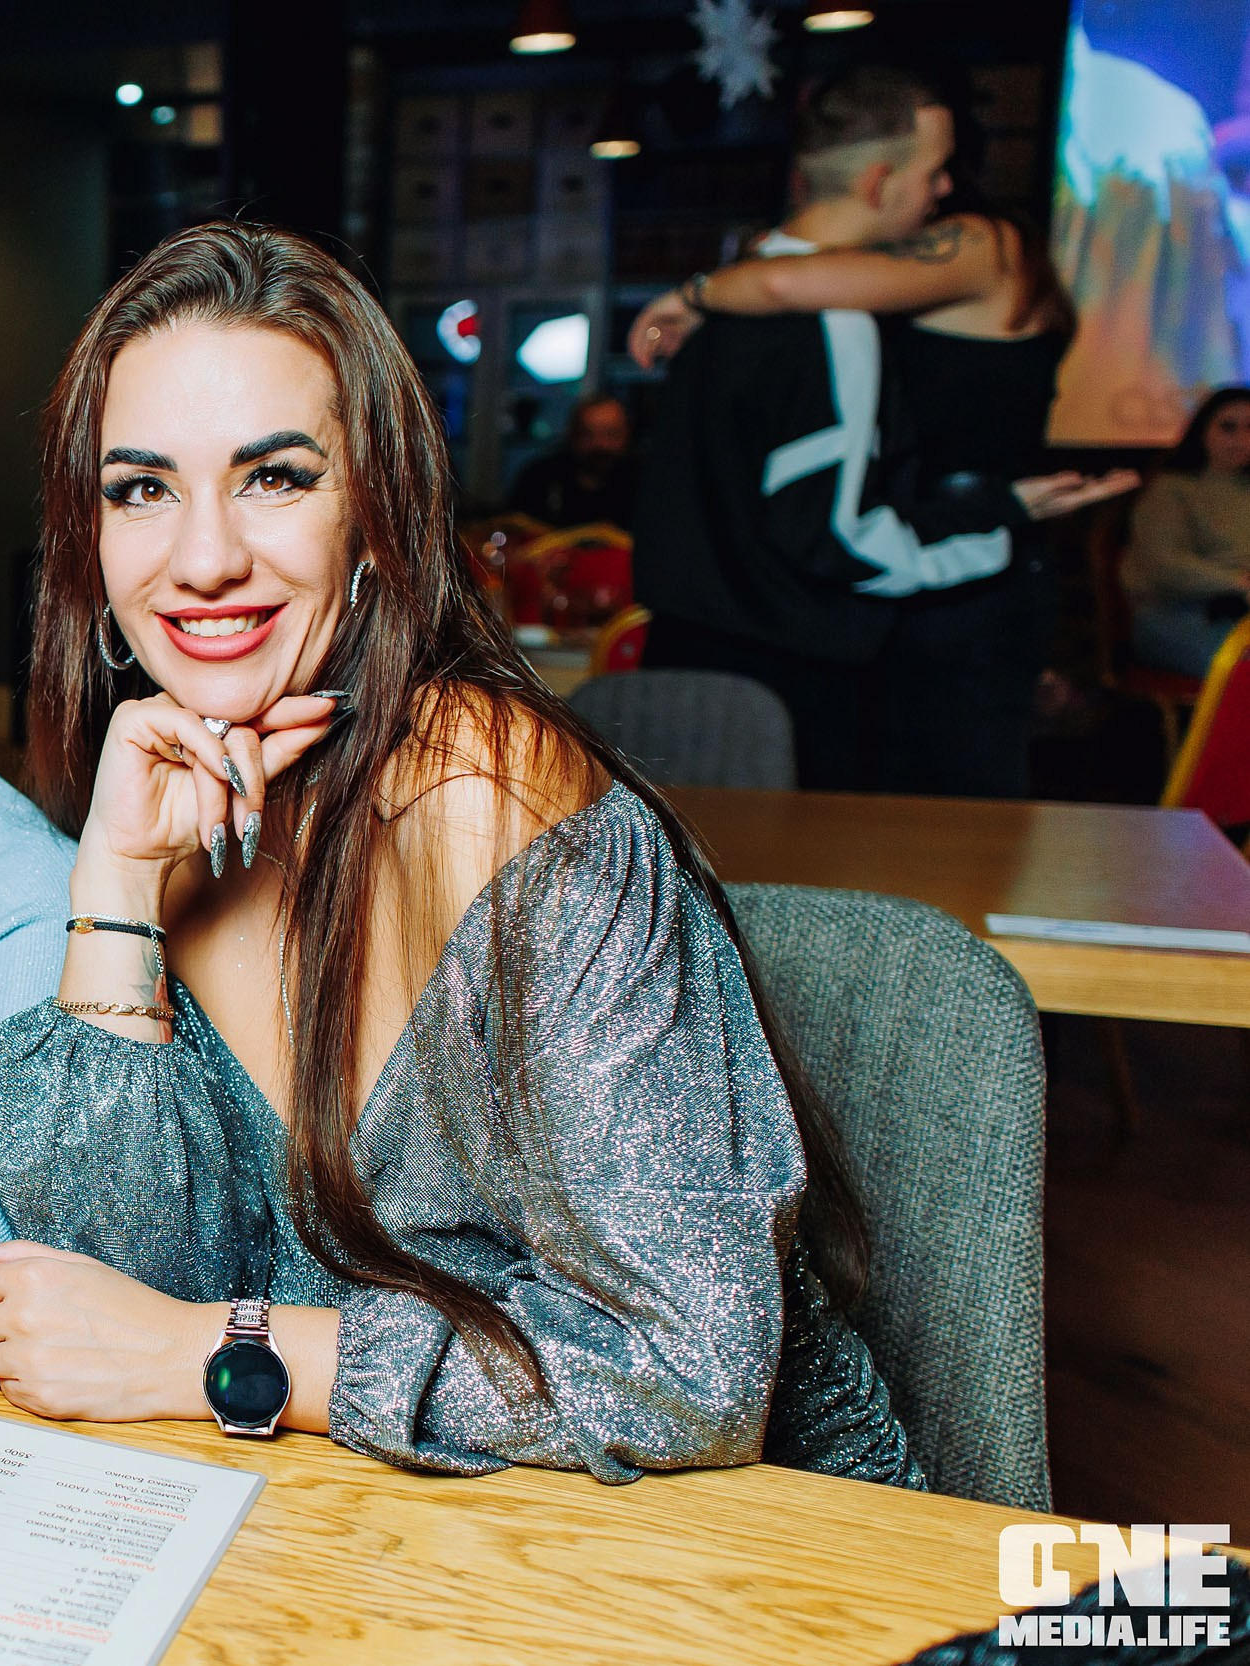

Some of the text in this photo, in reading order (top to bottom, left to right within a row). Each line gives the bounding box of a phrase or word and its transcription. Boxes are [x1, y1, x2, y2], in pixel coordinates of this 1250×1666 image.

[114, 1482, 138, 1492] Голд
[147, 1480, 199, 1494] Ольмека
[95, 1490, 131, 1502] Альтос
[140, 1489, 191, 1503] Ольмека
[134, 1498, 187, 1513] Ольмека
